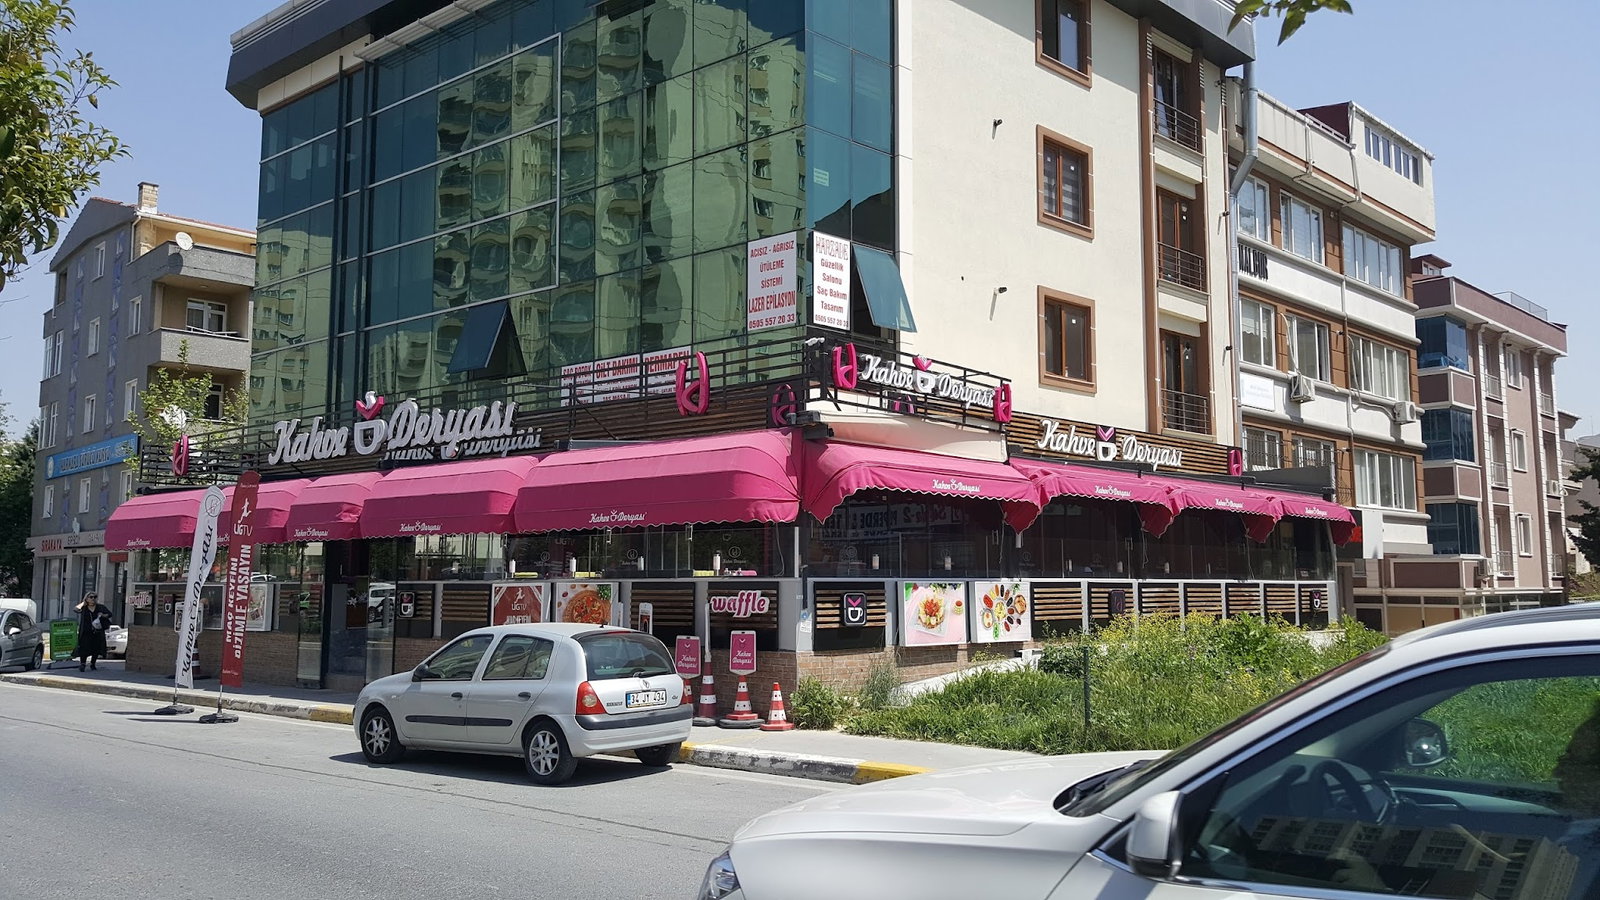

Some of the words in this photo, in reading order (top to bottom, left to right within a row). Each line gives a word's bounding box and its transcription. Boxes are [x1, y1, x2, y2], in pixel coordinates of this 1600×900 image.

[760, 259, 784, 273] ÜTÜLEME
[820, 258, 844, 272] Güzellik
[761, 275, 783, 289] SİSTEMİ
[822, 272, 842, 285] Salonu
[817, 286, 828, 297] Saç
[829, 289, 847, 301] Bakım
[749, 296, 766, 313] LAZER
[766, 291, 796, 311] EPİLASYON
[821, 301, 844, 313] Tasarım
[749, 318, 764, 329] 0505
[765, 316, 776, 326] 557
[778, 315, 786, 324] 20
[787, 313, 795, 322] 33
[862, 355, 914, 390] Kahve
[938, 373, 995, 408] Deryası
[268, 416, 349, 465] Kahve
[387, 398, 518, 453] Deryası
[1037, 419, 1096, 456] Kahve
[1121, 435, 1183, 471] Deryası
[236, 544, 252, 602] YAŞAYIN
[711, 591, 769, 617] waffle
[226, 612, 234, 643] MAÇ
[631, 694, 640, 704] 34
[653, 692, 664, 702] 434
